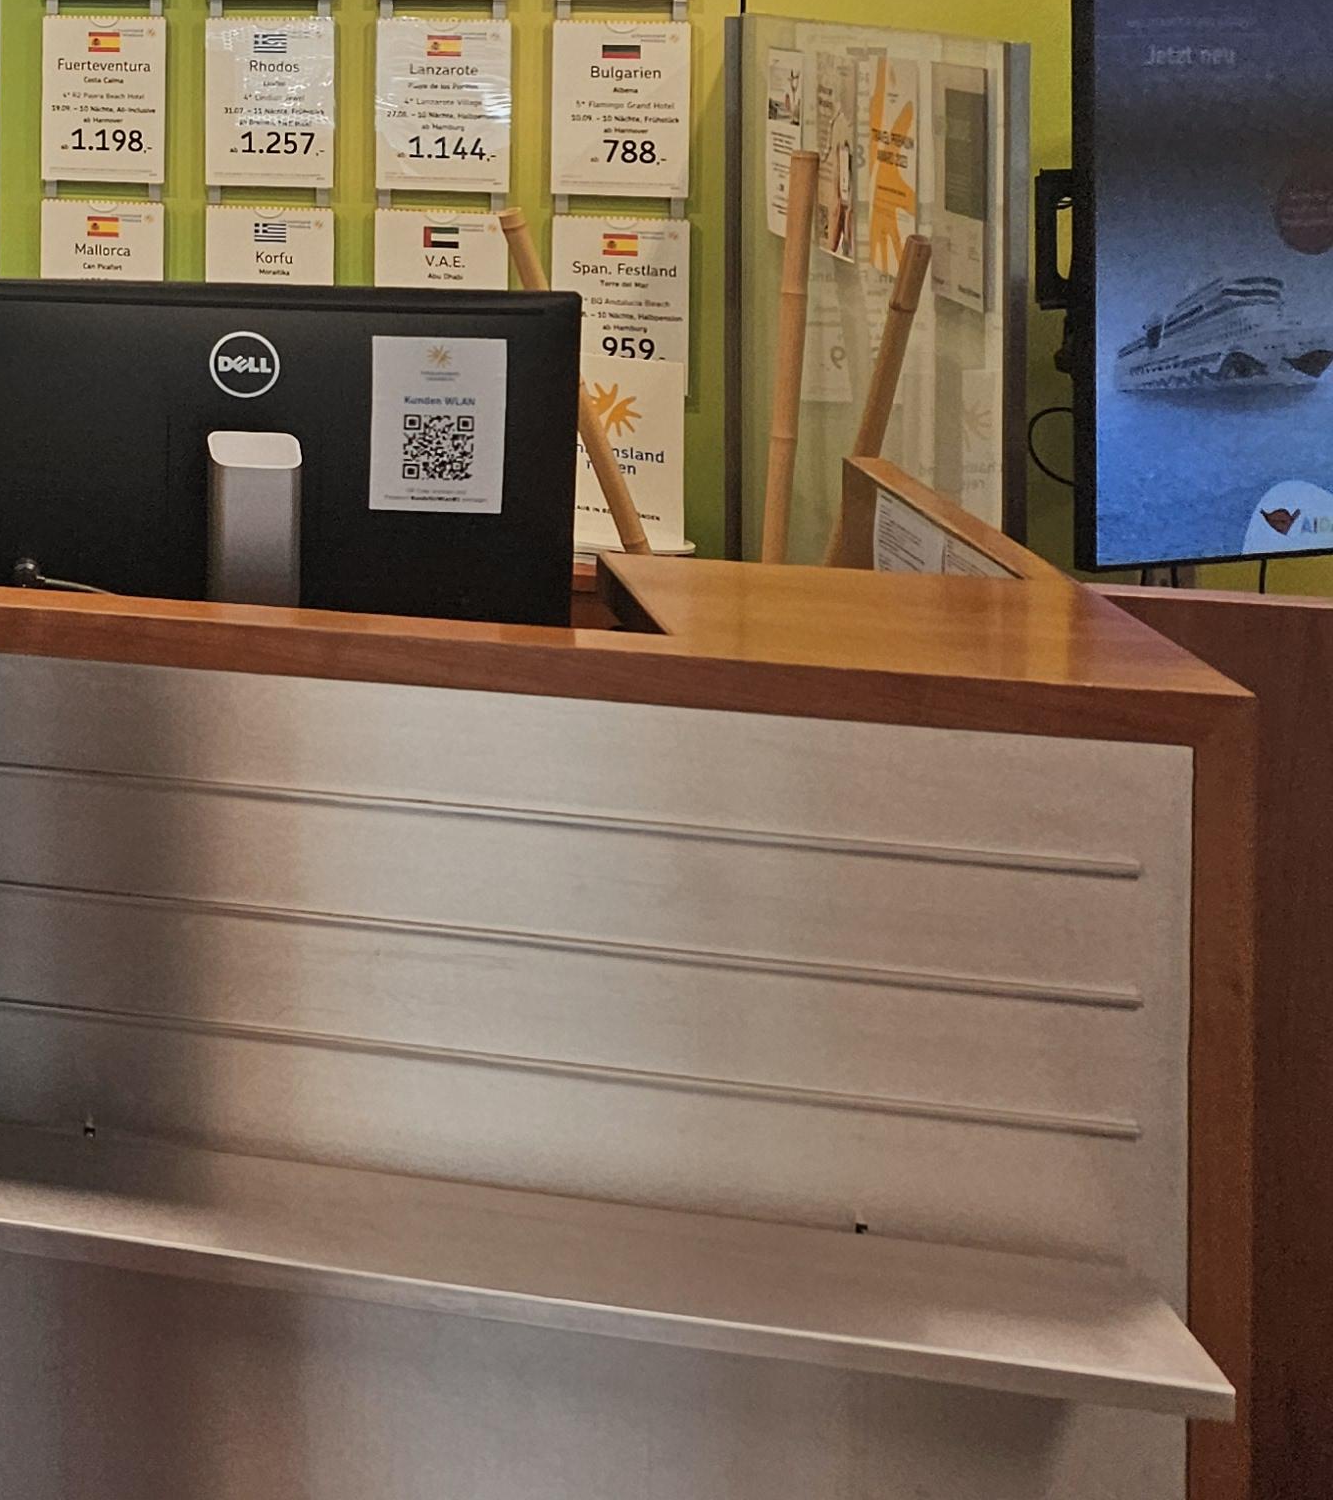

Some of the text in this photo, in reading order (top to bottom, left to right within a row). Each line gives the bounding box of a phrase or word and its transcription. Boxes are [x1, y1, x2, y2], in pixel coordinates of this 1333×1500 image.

[57, 58, 151, 72] Fuerteventura
[249, 60, 300, 72] Rhodos
[410, 64, 479, 76] Lanzarote
[590, 66, 662, 81] Bulgarien
[71, 129, 152, 153] 1.198,-
[241, 131, 325, 157] 1.257,-
[409, 136, 497, 162] 1.144,-
[603, 140, 667, 165] 788,-
[75, 243, 131, 257] Mallorca
[256, 251, 293, 264] Korfu
[425, 255, 466, 268] V.A.E.
[573, 261, 677, 278] Span. Festland
[218, 356, 272, 373] DELL
[445, 397, 475, 406] WLAN
[1301, 516, 1333, 533] AID
